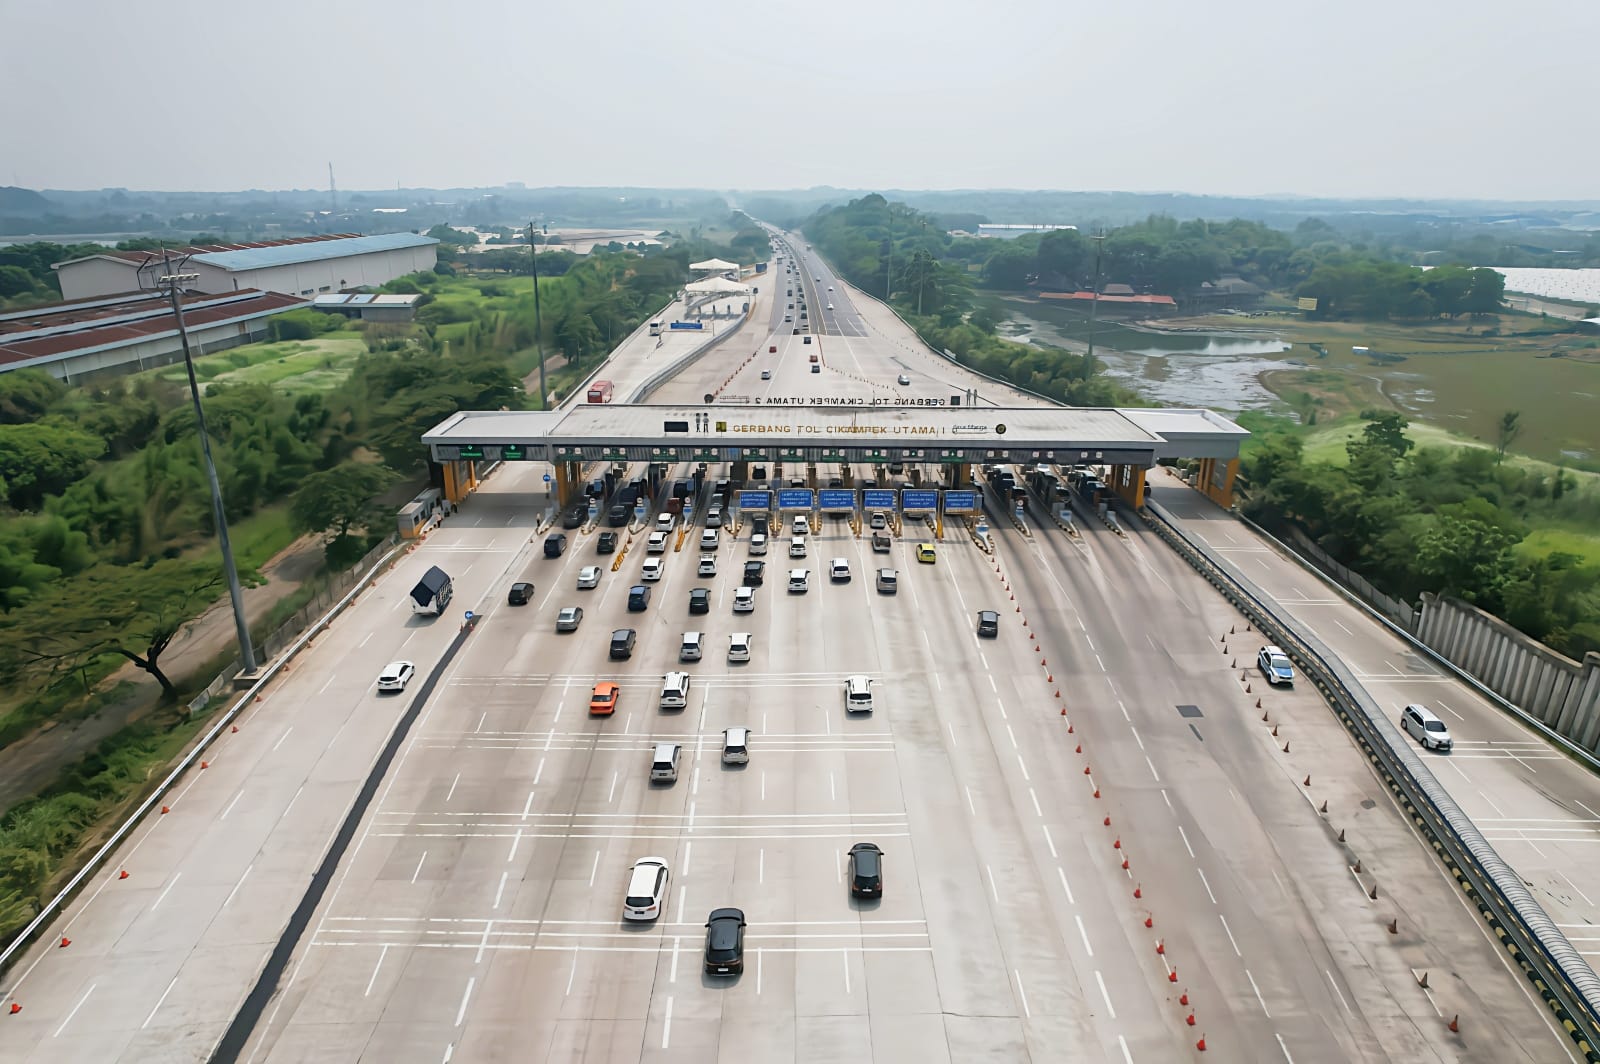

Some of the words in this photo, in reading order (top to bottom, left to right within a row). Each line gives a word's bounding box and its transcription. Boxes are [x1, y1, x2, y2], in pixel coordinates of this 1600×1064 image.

[733, 425, 791, 433] GERBANG
[796, 425, 822, 433] TOL
[893, 426, 936, 434] UTAMA
